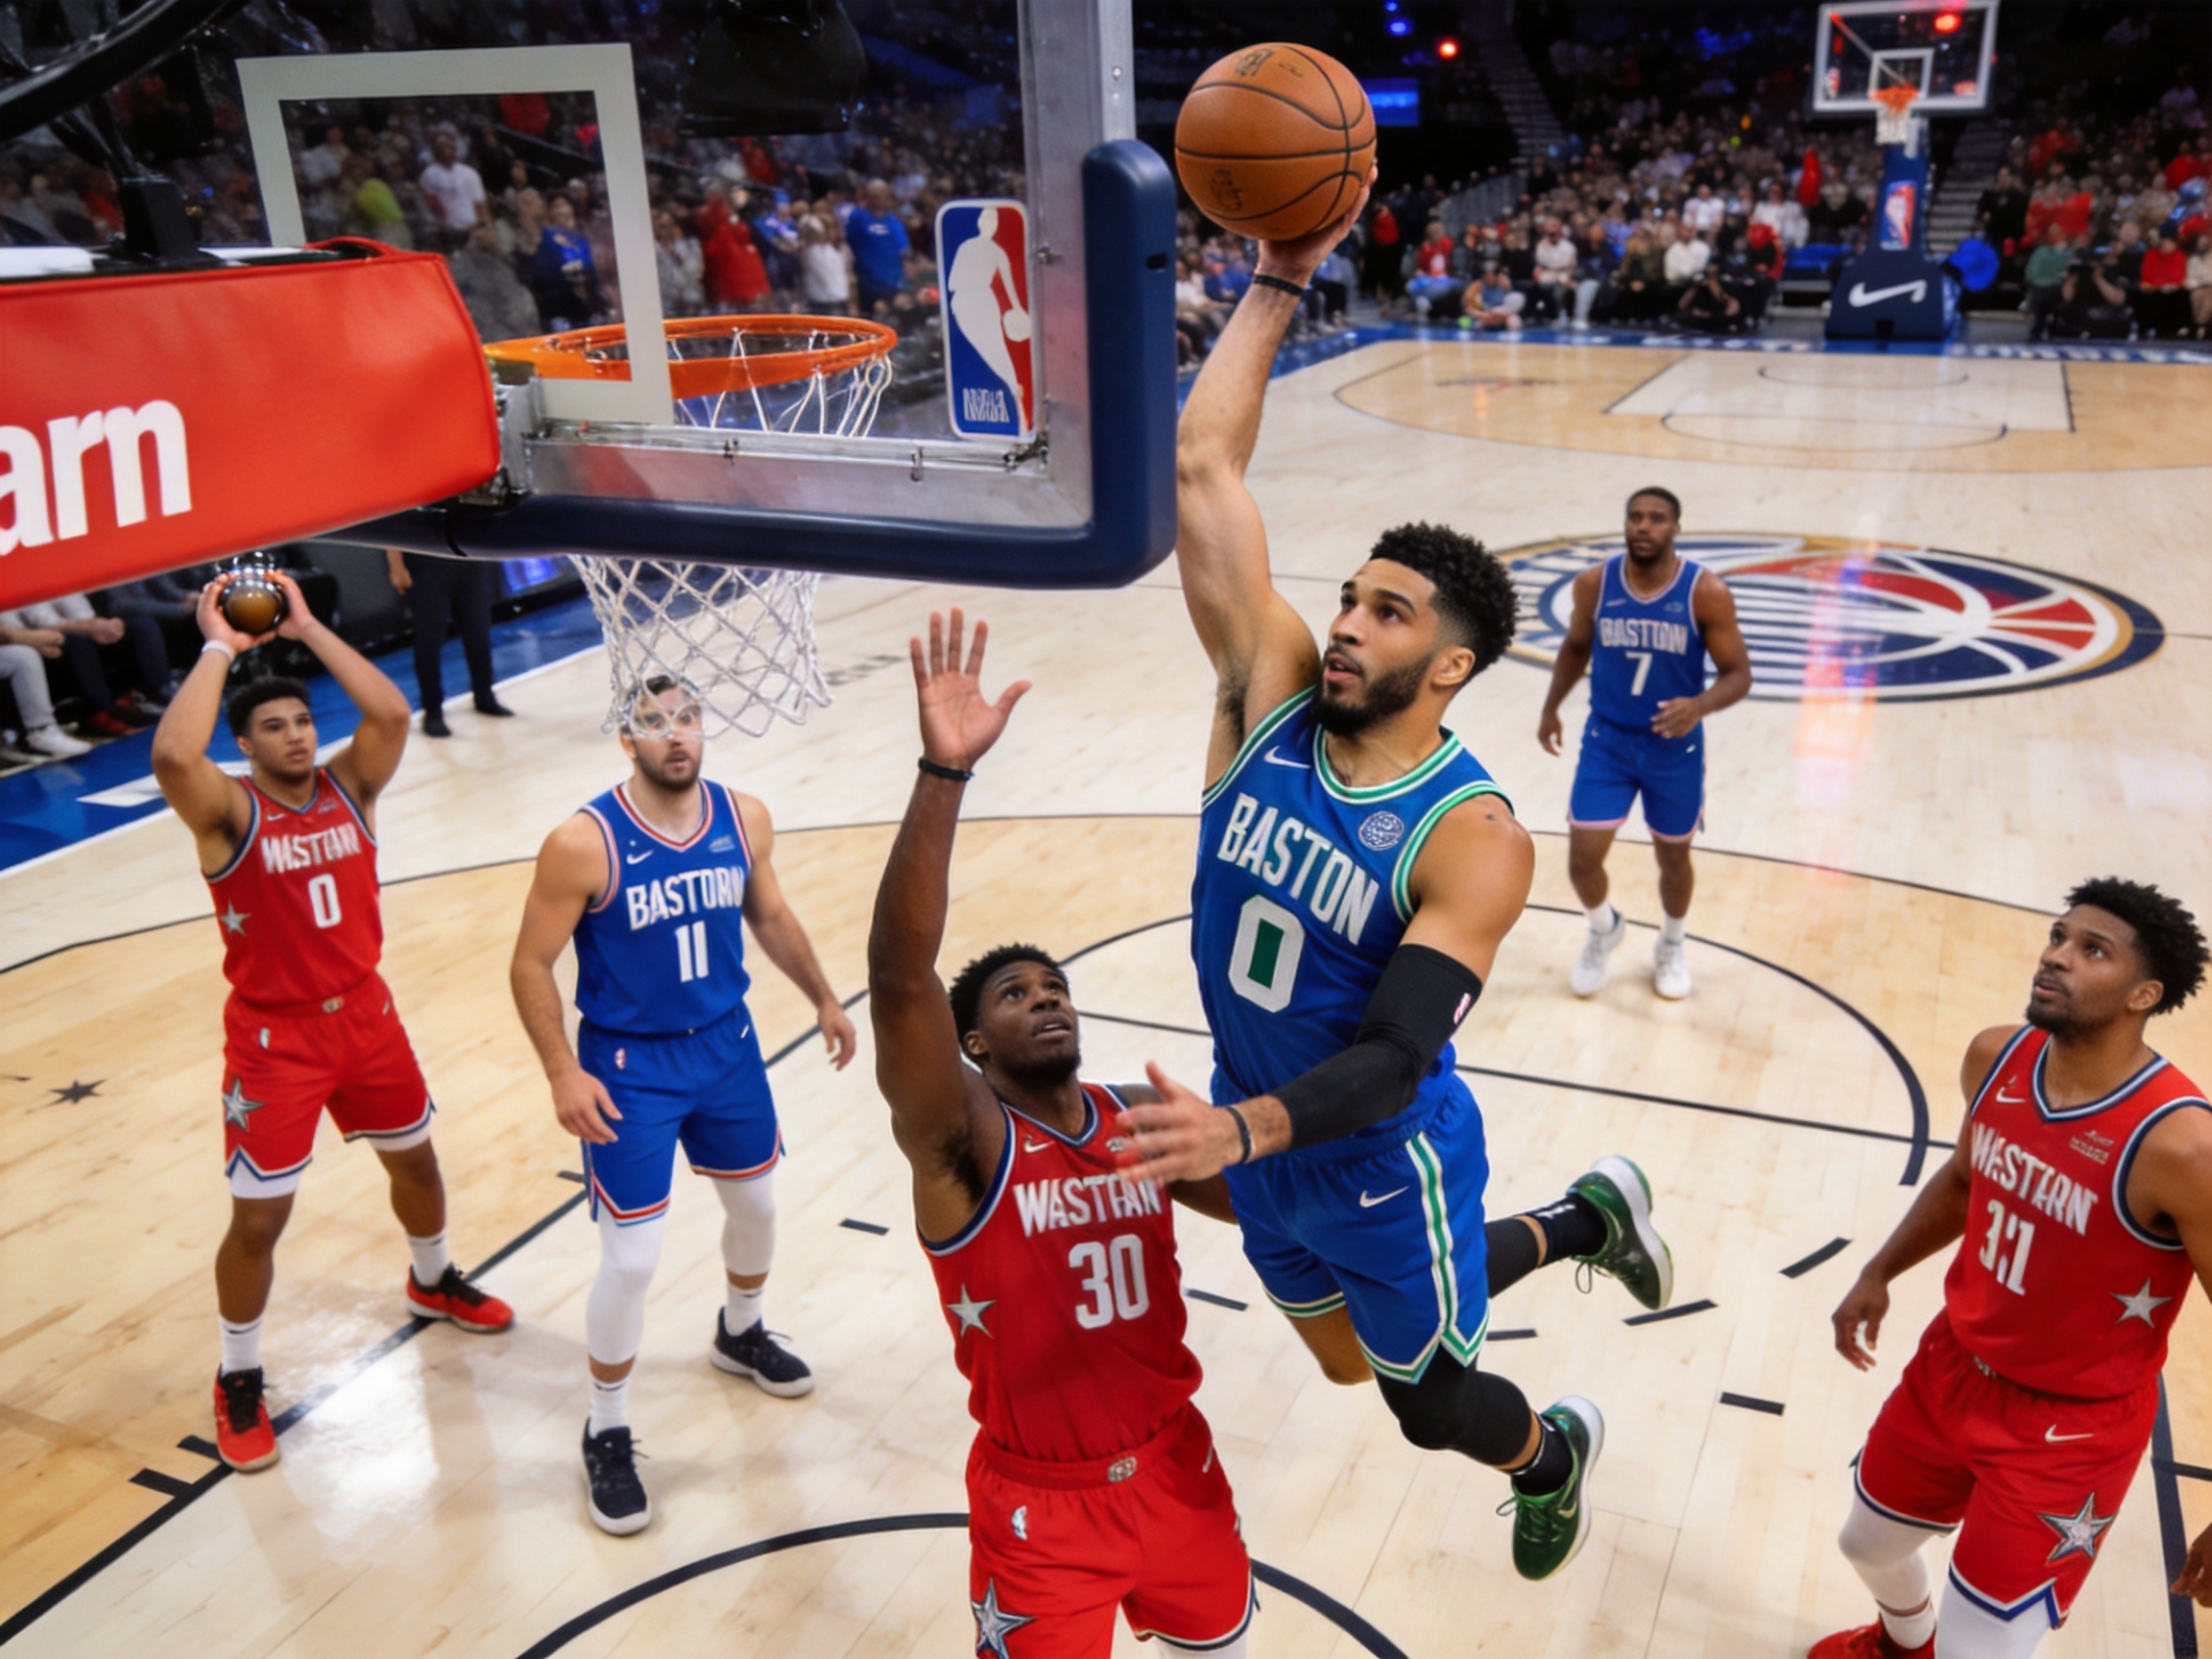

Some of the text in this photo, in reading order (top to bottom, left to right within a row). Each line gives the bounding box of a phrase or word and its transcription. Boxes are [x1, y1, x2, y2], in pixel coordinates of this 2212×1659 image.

[1624, 651, 1652, 696] 7
[308, 873, 342, 928] 0
[1217, 792, 1380, 946] BASTON
[675, 921, 709, 982] 11
[1228, 894, 1306, 1013] 0
[1069, 1234, 1150, 1330] 30
